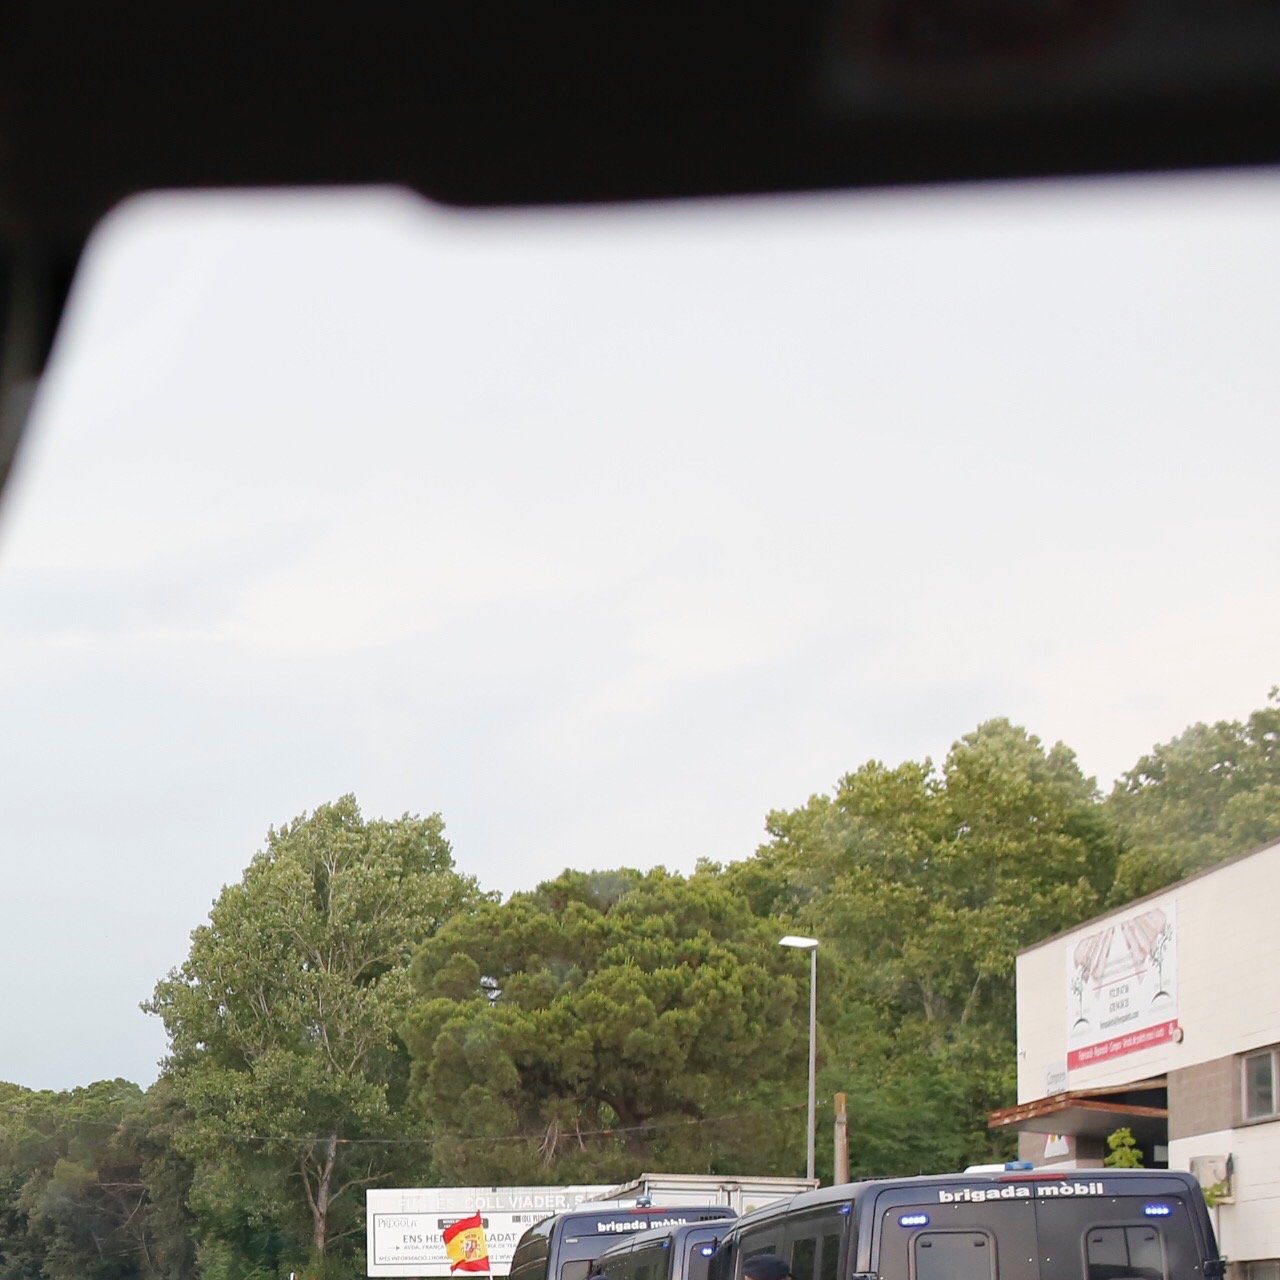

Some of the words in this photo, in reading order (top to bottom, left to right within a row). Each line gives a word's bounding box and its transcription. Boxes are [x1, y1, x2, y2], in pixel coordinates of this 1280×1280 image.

[939, 1185, 1030, 1202] brigada
[1038, 1182, 1104, 1196] mòbil
[597, 1220, 646, 1232] brigada
[403, 1234, 423, 1243] ENS
[484, 1233, 517, 1242] LADAT
